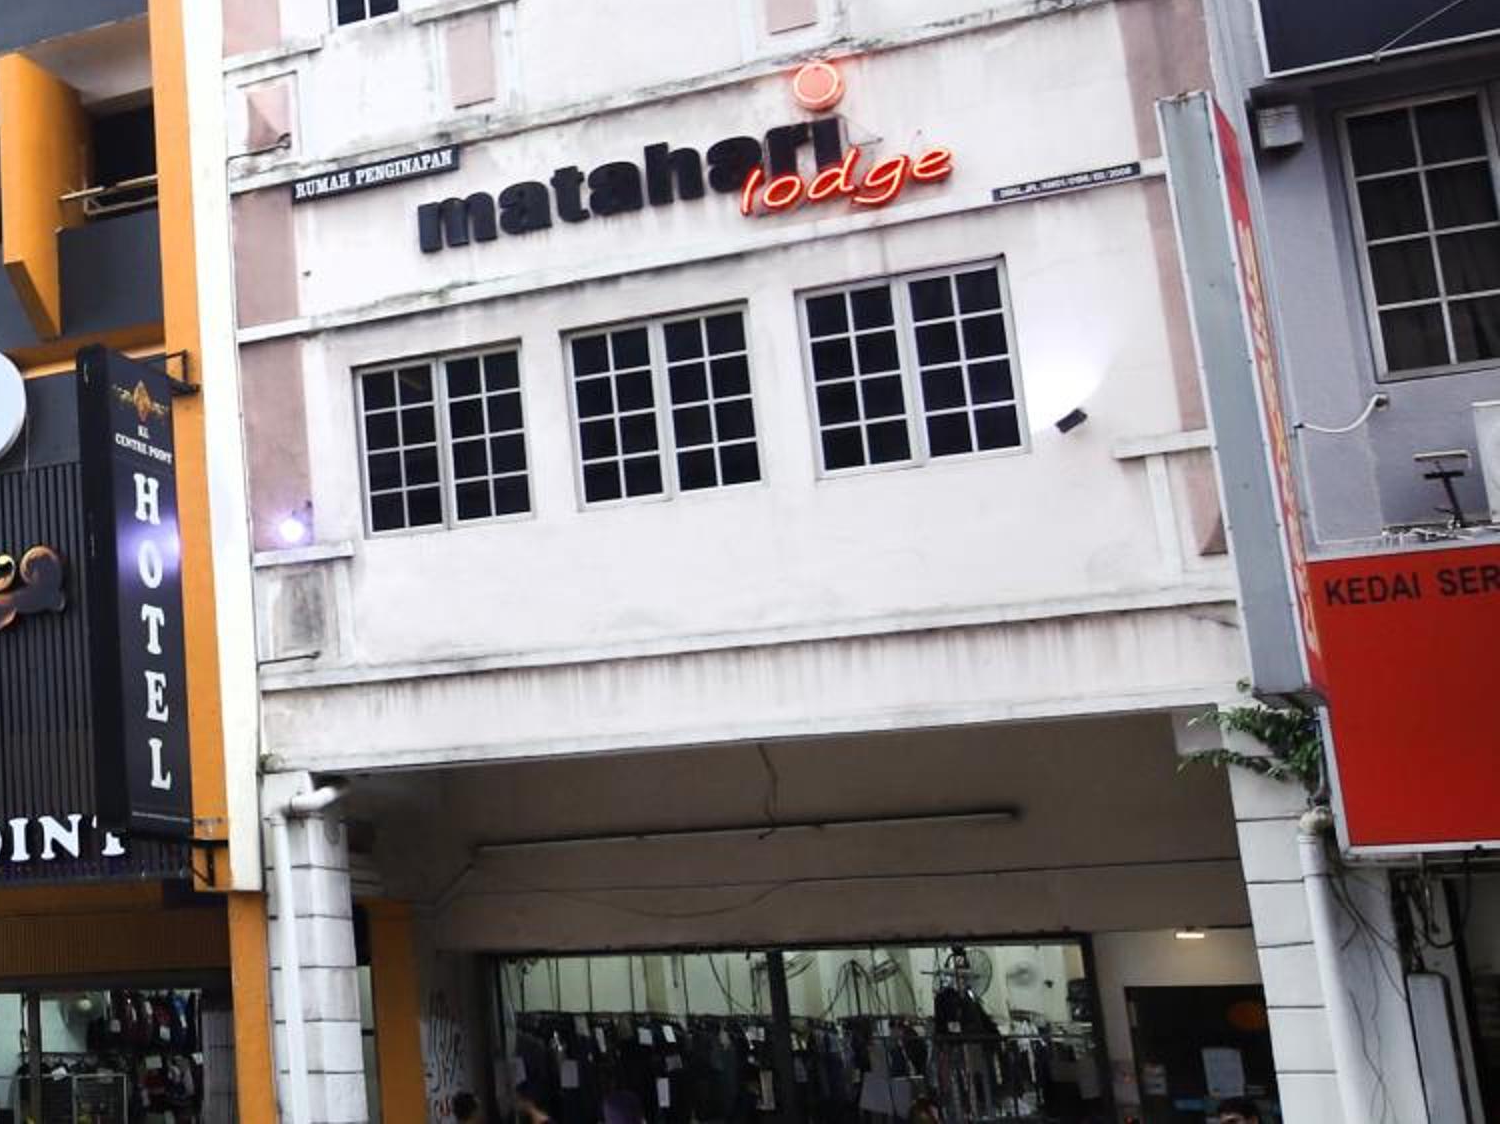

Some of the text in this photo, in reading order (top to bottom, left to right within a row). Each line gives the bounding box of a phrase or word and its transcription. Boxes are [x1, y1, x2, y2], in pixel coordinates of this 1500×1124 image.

[294, 151, 453, 200] RUMAH PENGINAPAN
[740, 143, 956, 217] lodge
[115, 433, 173, 465] CENTRE POINT
[1324, 572, 1422, 606] KEDAI
[133, 473, 172, 790] HOTEL
